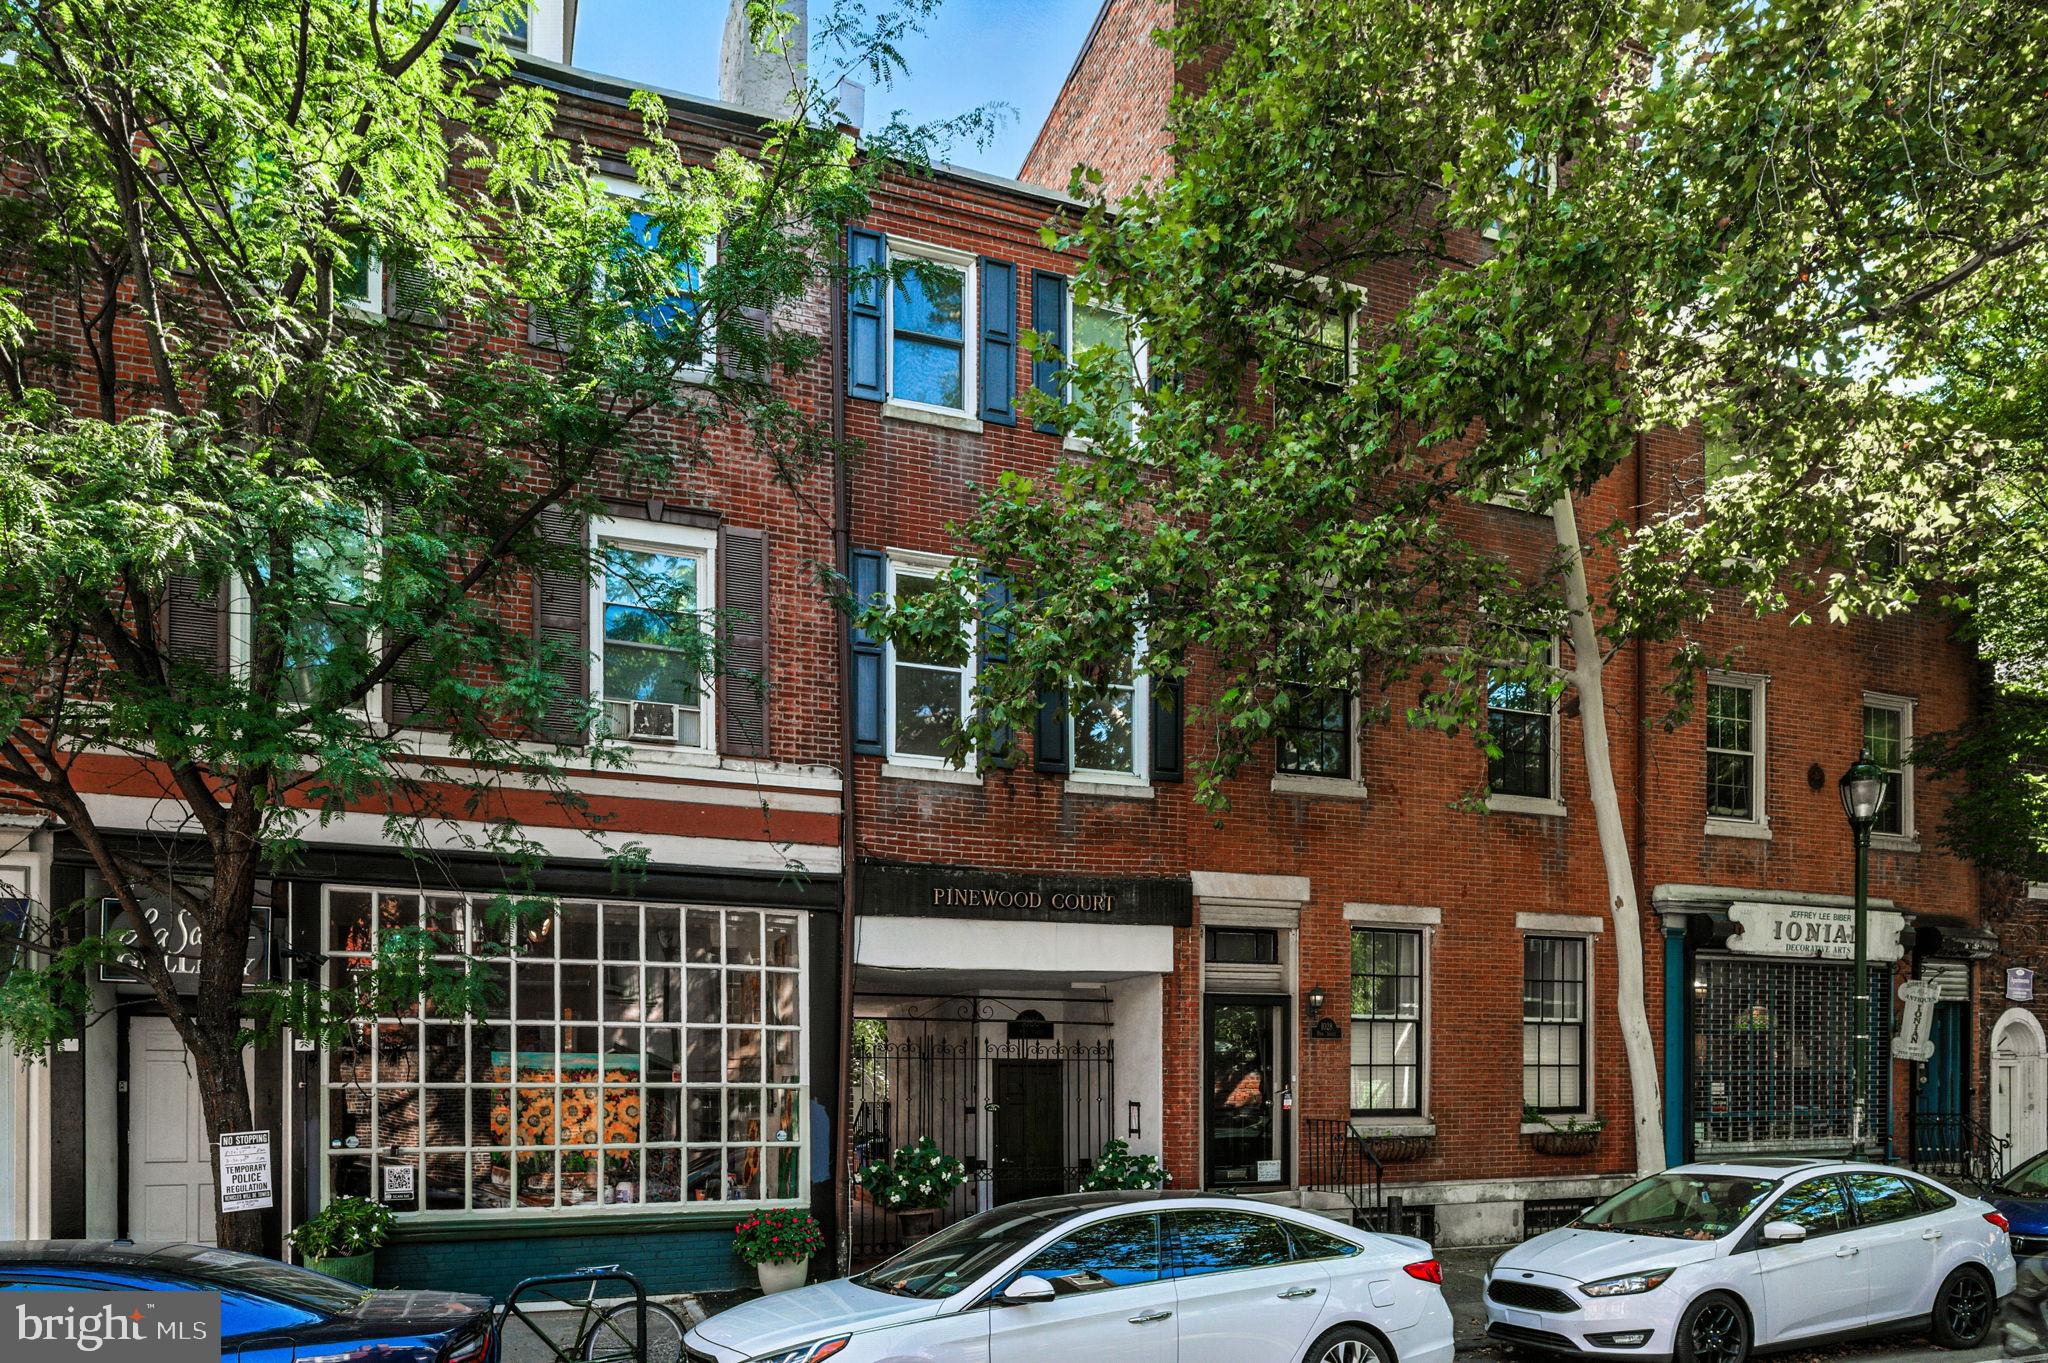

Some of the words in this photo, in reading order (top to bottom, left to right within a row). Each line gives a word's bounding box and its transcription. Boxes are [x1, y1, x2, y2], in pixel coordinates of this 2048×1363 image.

[933, 888, 1042, 909] PINEWOOD
[1051, 893, 1115, 912] COURT
[1789, 910, 1817, 920] JEFFREY
[1819, 912, 1831, 920] LEE
[1833, 913, 1852, 922] BIBER
[1785, 943, 1831, 953] DECORATIVE
[1833, 945, 1851, 954] ARTS
[222, 1136, 233, 1146] NO
[235, 1134, 268, 1145] STOPPING
[225, 1163, 267, 1174] TEMPORARY
[232, 1172, 262, 1184] POLICE
[226, 1182, 268, 1194] REGULATION
